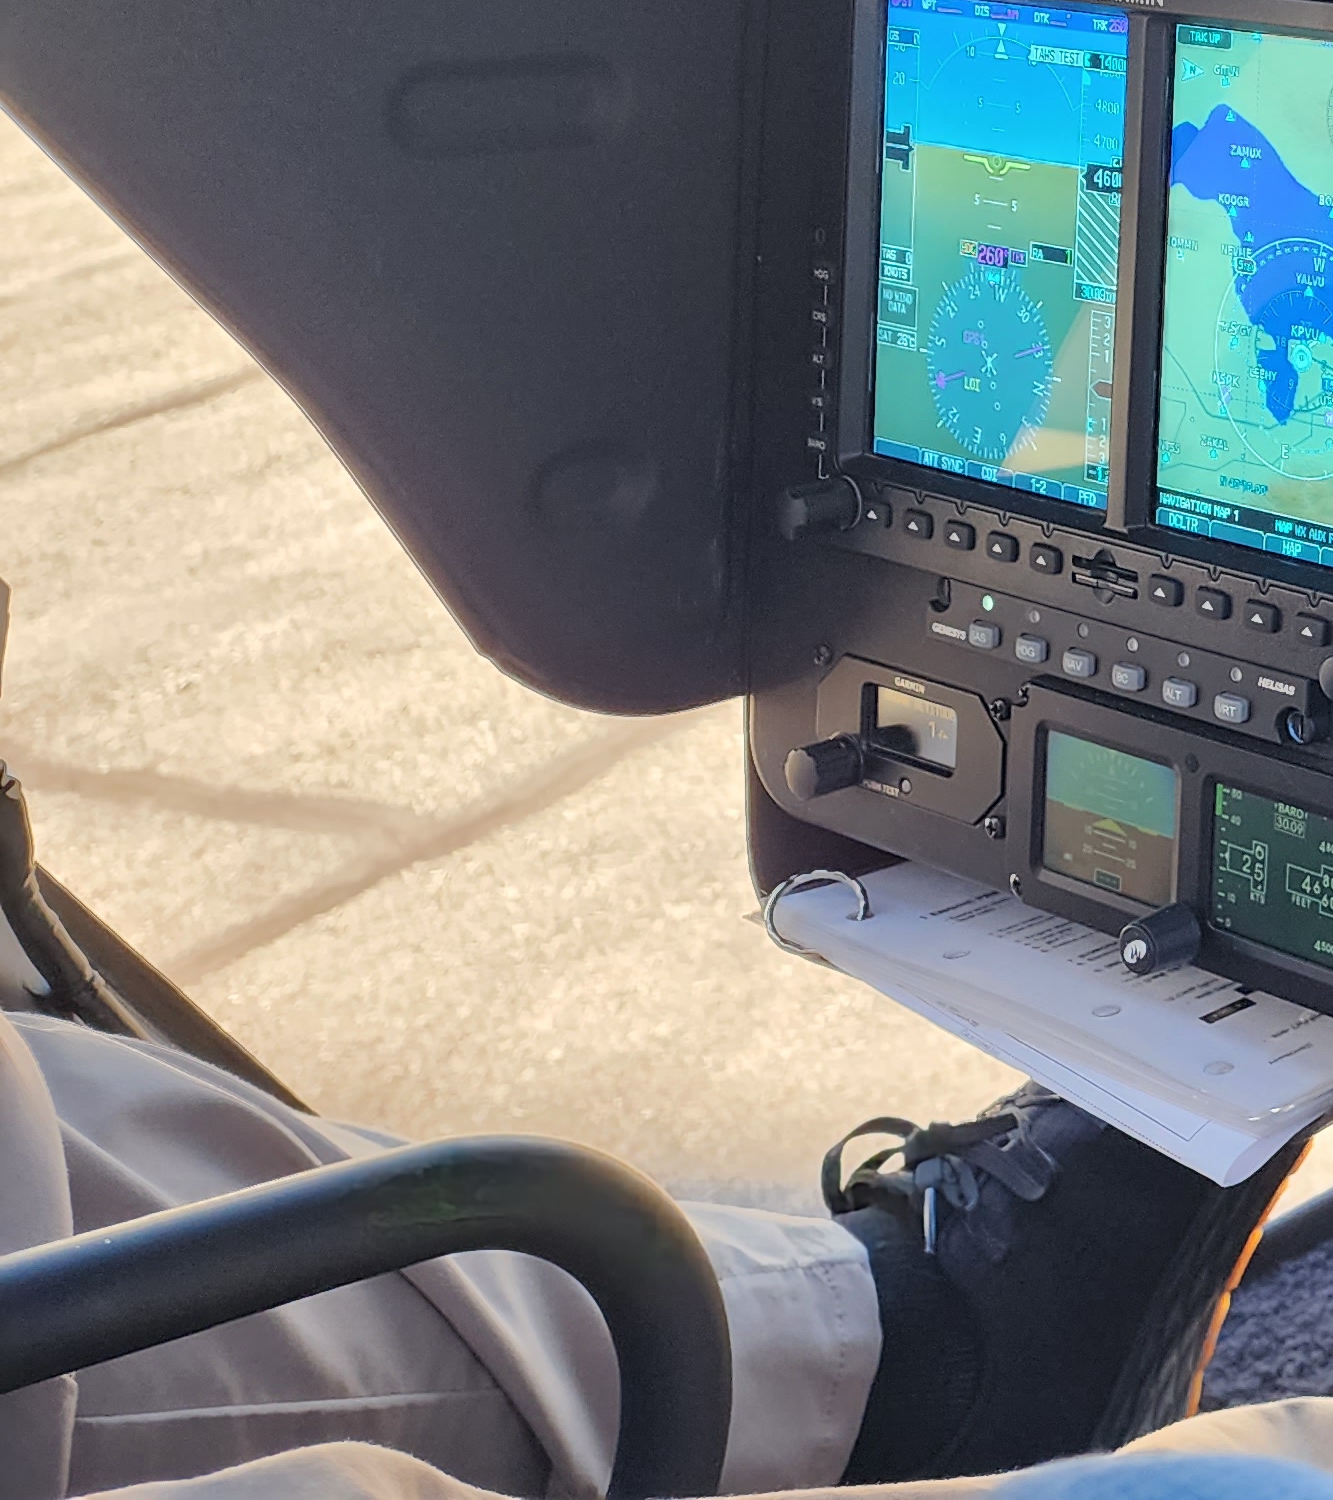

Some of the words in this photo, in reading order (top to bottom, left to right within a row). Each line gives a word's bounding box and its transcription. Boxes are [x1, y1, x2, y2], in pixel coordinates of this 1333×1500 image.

[1059, 49, 1081, 64] TEST
[1160, 492, 1212, 516] NAVIGATION
[1277, 802, 1304, 819] BARO
